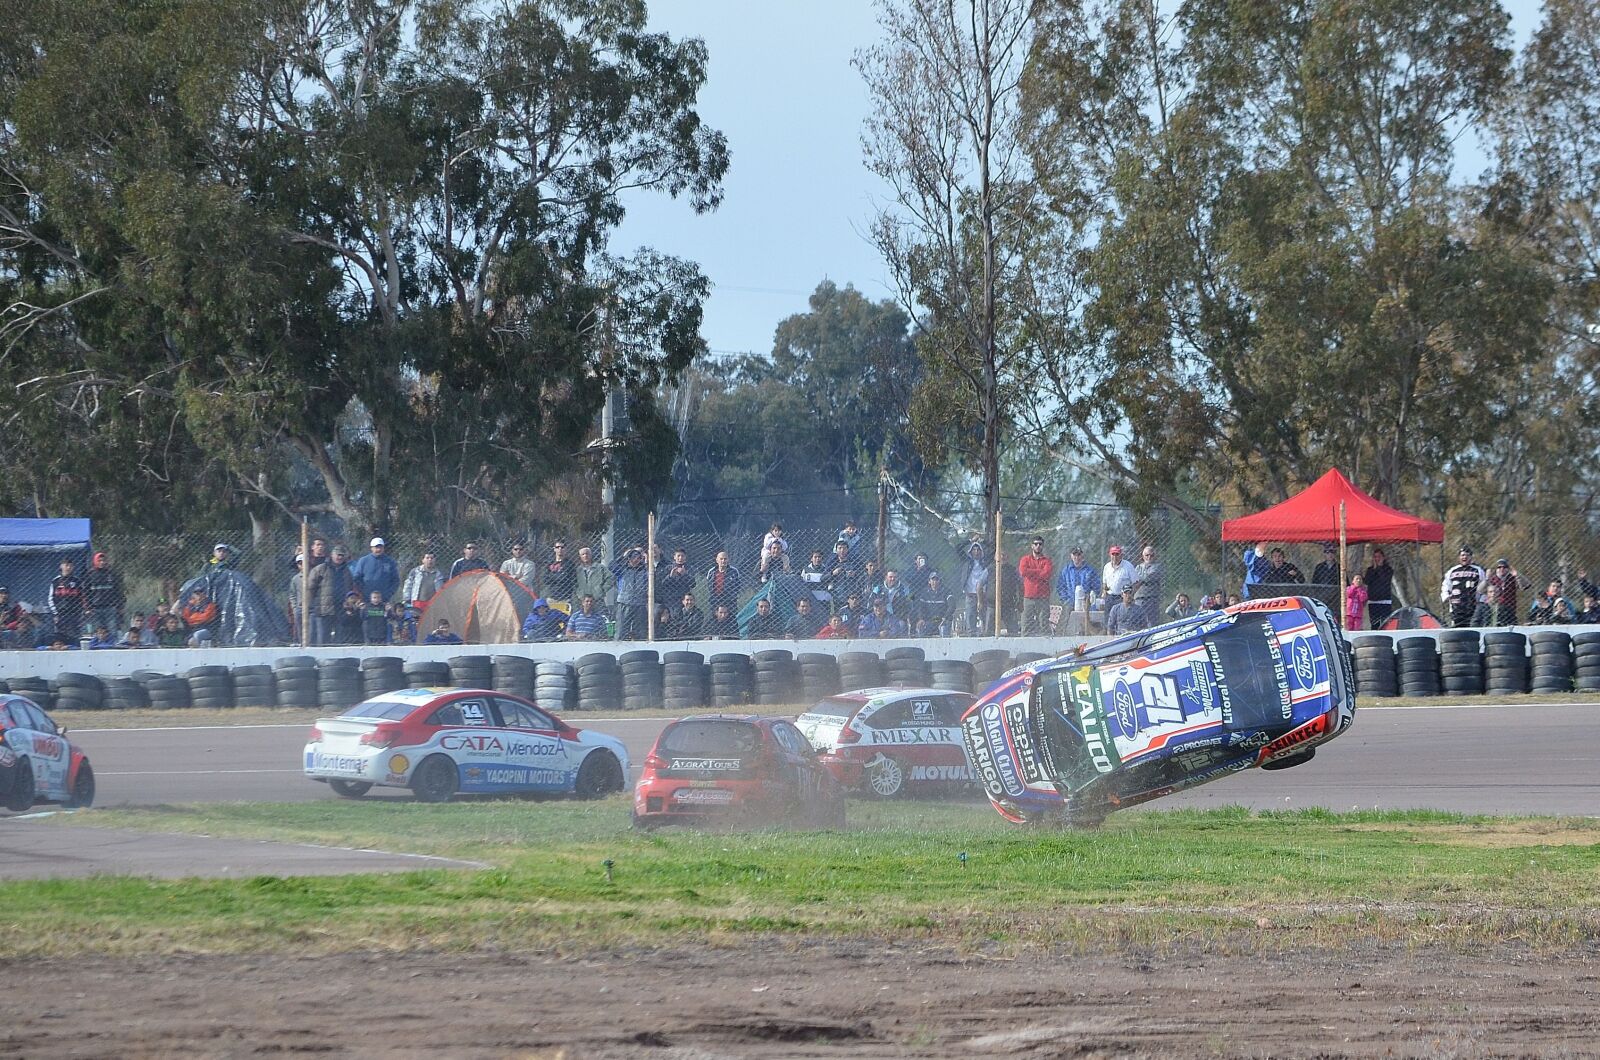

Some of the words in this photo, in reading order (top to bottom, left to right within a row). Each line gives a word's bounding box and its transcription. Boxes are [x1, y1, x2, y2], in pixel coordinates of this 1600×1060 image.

[1205, 641, 1226, 682] Virtual
[1267, 638, 1281, 660] ESTE
[1296, 646, 1313, 679] Ford
[1274, 661, 1286, 680] DEL
[462, 704, 484, 719] 14
[914, 701, 930, 714] 27
[1117, 692, 1133, 728] Ford
[1141, 674, 1184, 724] 12
[1218, 684, 1233, 724] Litoral
[1278, 681, 1292, 720] CIRUGIA
[441, 735, 504, 752] CATA
[1013, 707, 1038, 779] ospim
[1075, 683, 1112, 773] CALICO
[707, 759, 740, 769] TOURS
[966, 715, 1003, 795] MARIGO
[986, 720, 1005, 754] AGUA
[997, 754, 1020, 795] CLARA
[486, 769, 527, 784] YACOPINI
[529, 770, 566, 785] MOTORS
[910, 765, 970, 780] MOTUL
